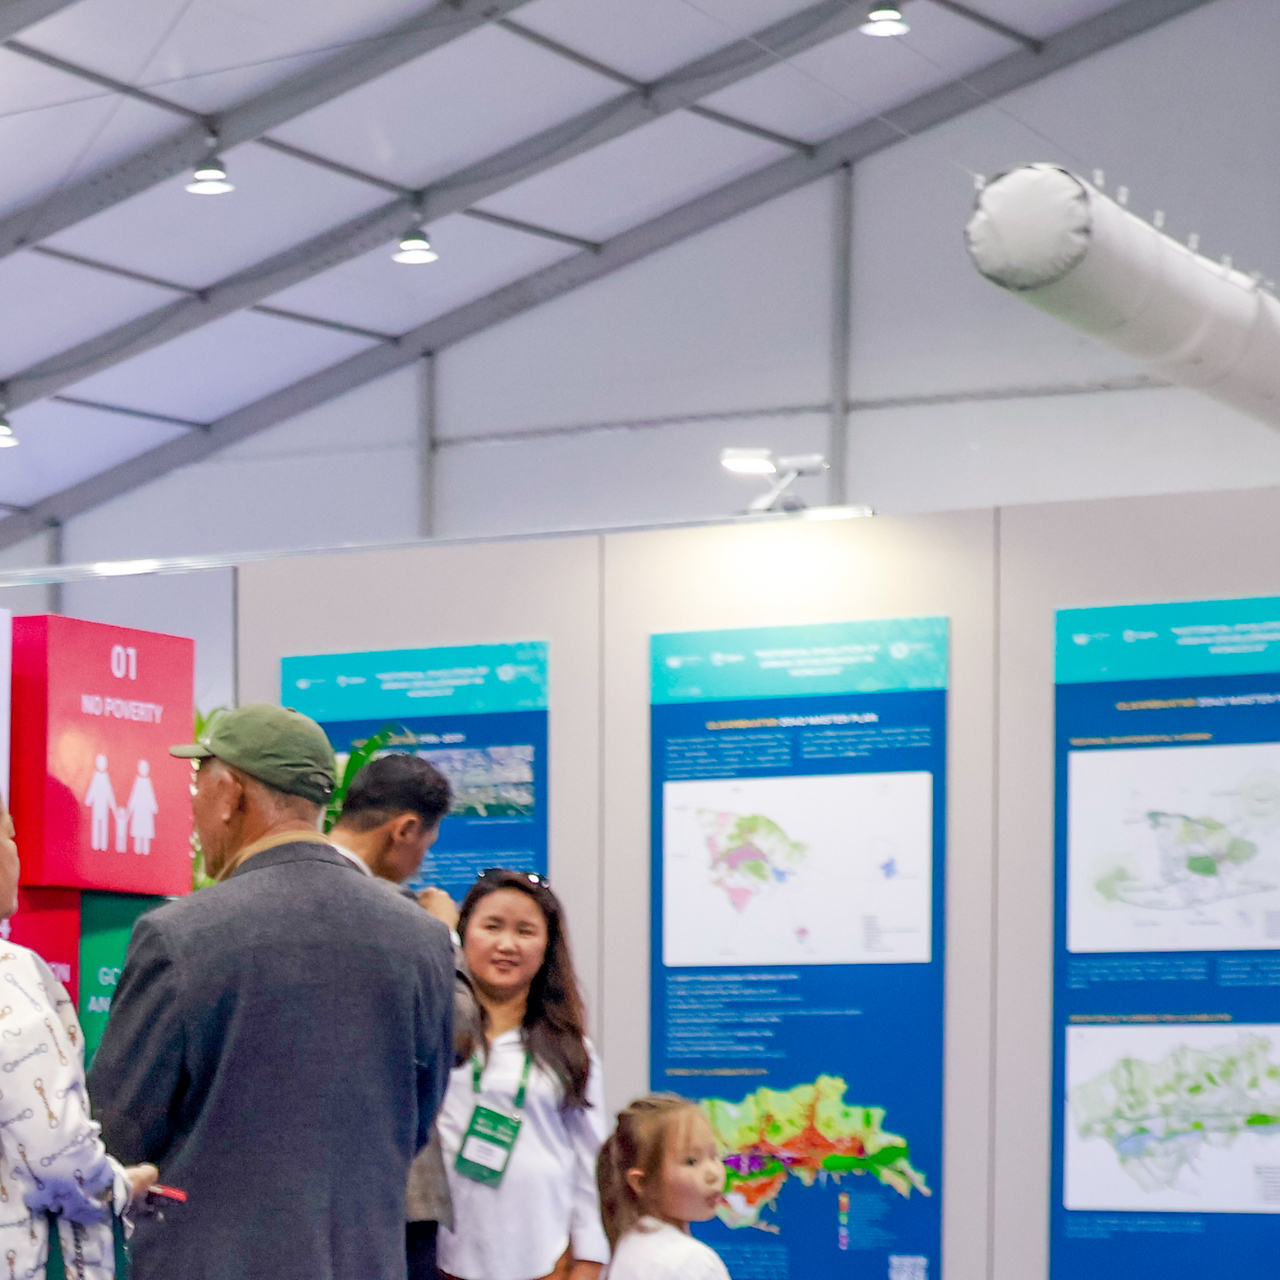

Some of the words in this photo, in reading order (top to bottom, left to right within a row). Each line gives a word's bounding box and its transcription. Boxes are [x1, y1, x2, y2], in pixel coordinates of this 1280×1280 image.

[110, 644, 138, 681] 01
[80, 693, 103, 717] NO
[104, 697, 164, 724] POVERTY
